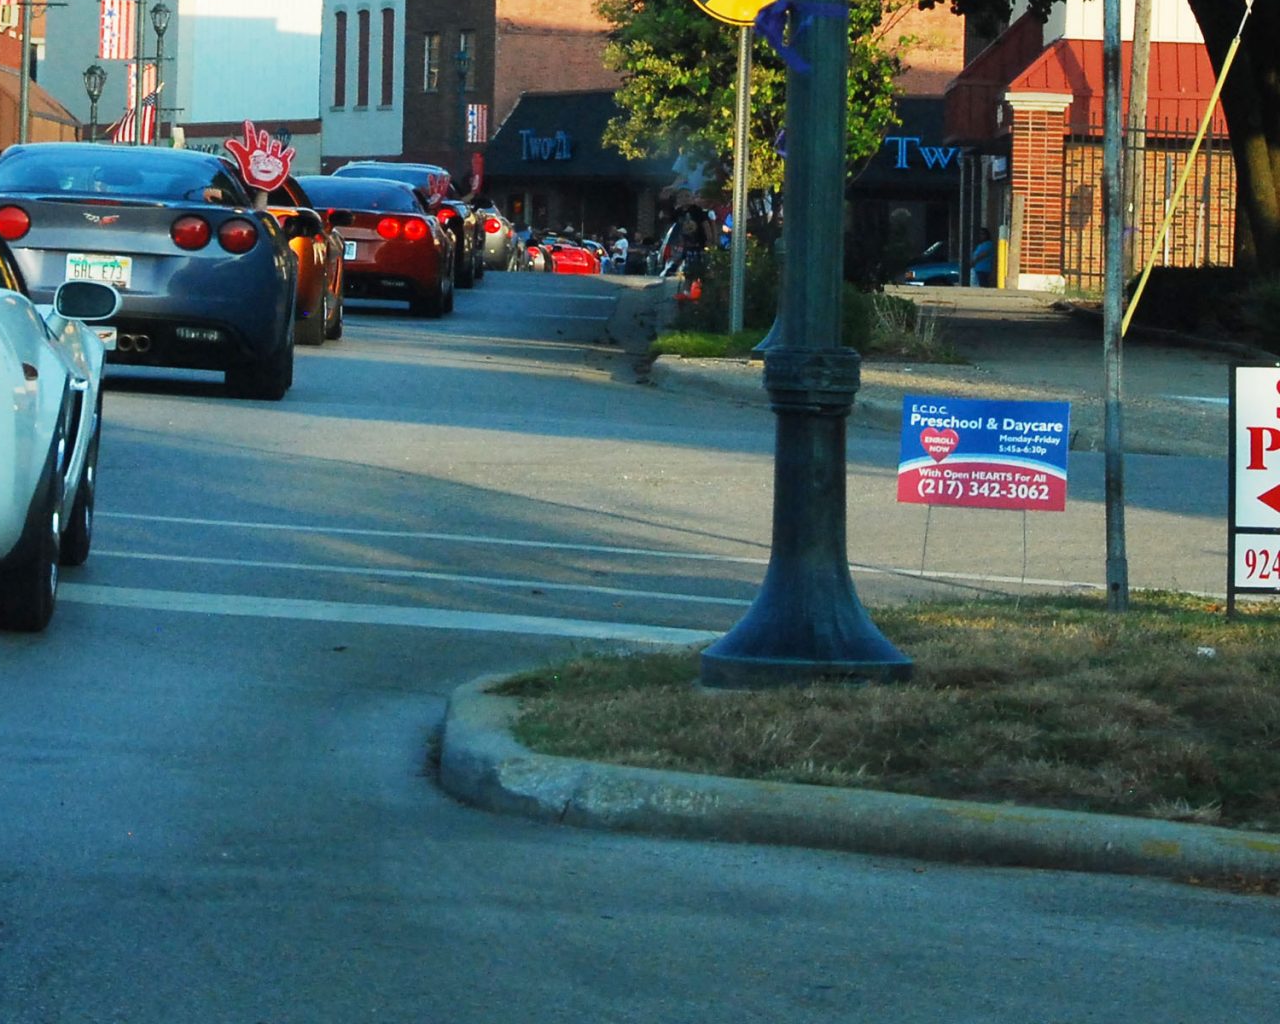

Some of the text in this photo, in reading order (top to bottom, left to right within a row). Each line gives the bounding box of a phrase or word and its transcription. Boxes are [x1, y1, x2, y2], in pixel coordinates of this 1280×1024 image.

[911, 404, 949, 415] E.C.D.C.
[910, 414, 1064, 436] Preschool & Daycare
[924, 436, 956, 445] ENROLL
[928, 445, 951, 454] NOW
[918, 467, 1048, 484] With Open HEARTS For All
[917, 478, 1050, 501] (217) 342-3062
